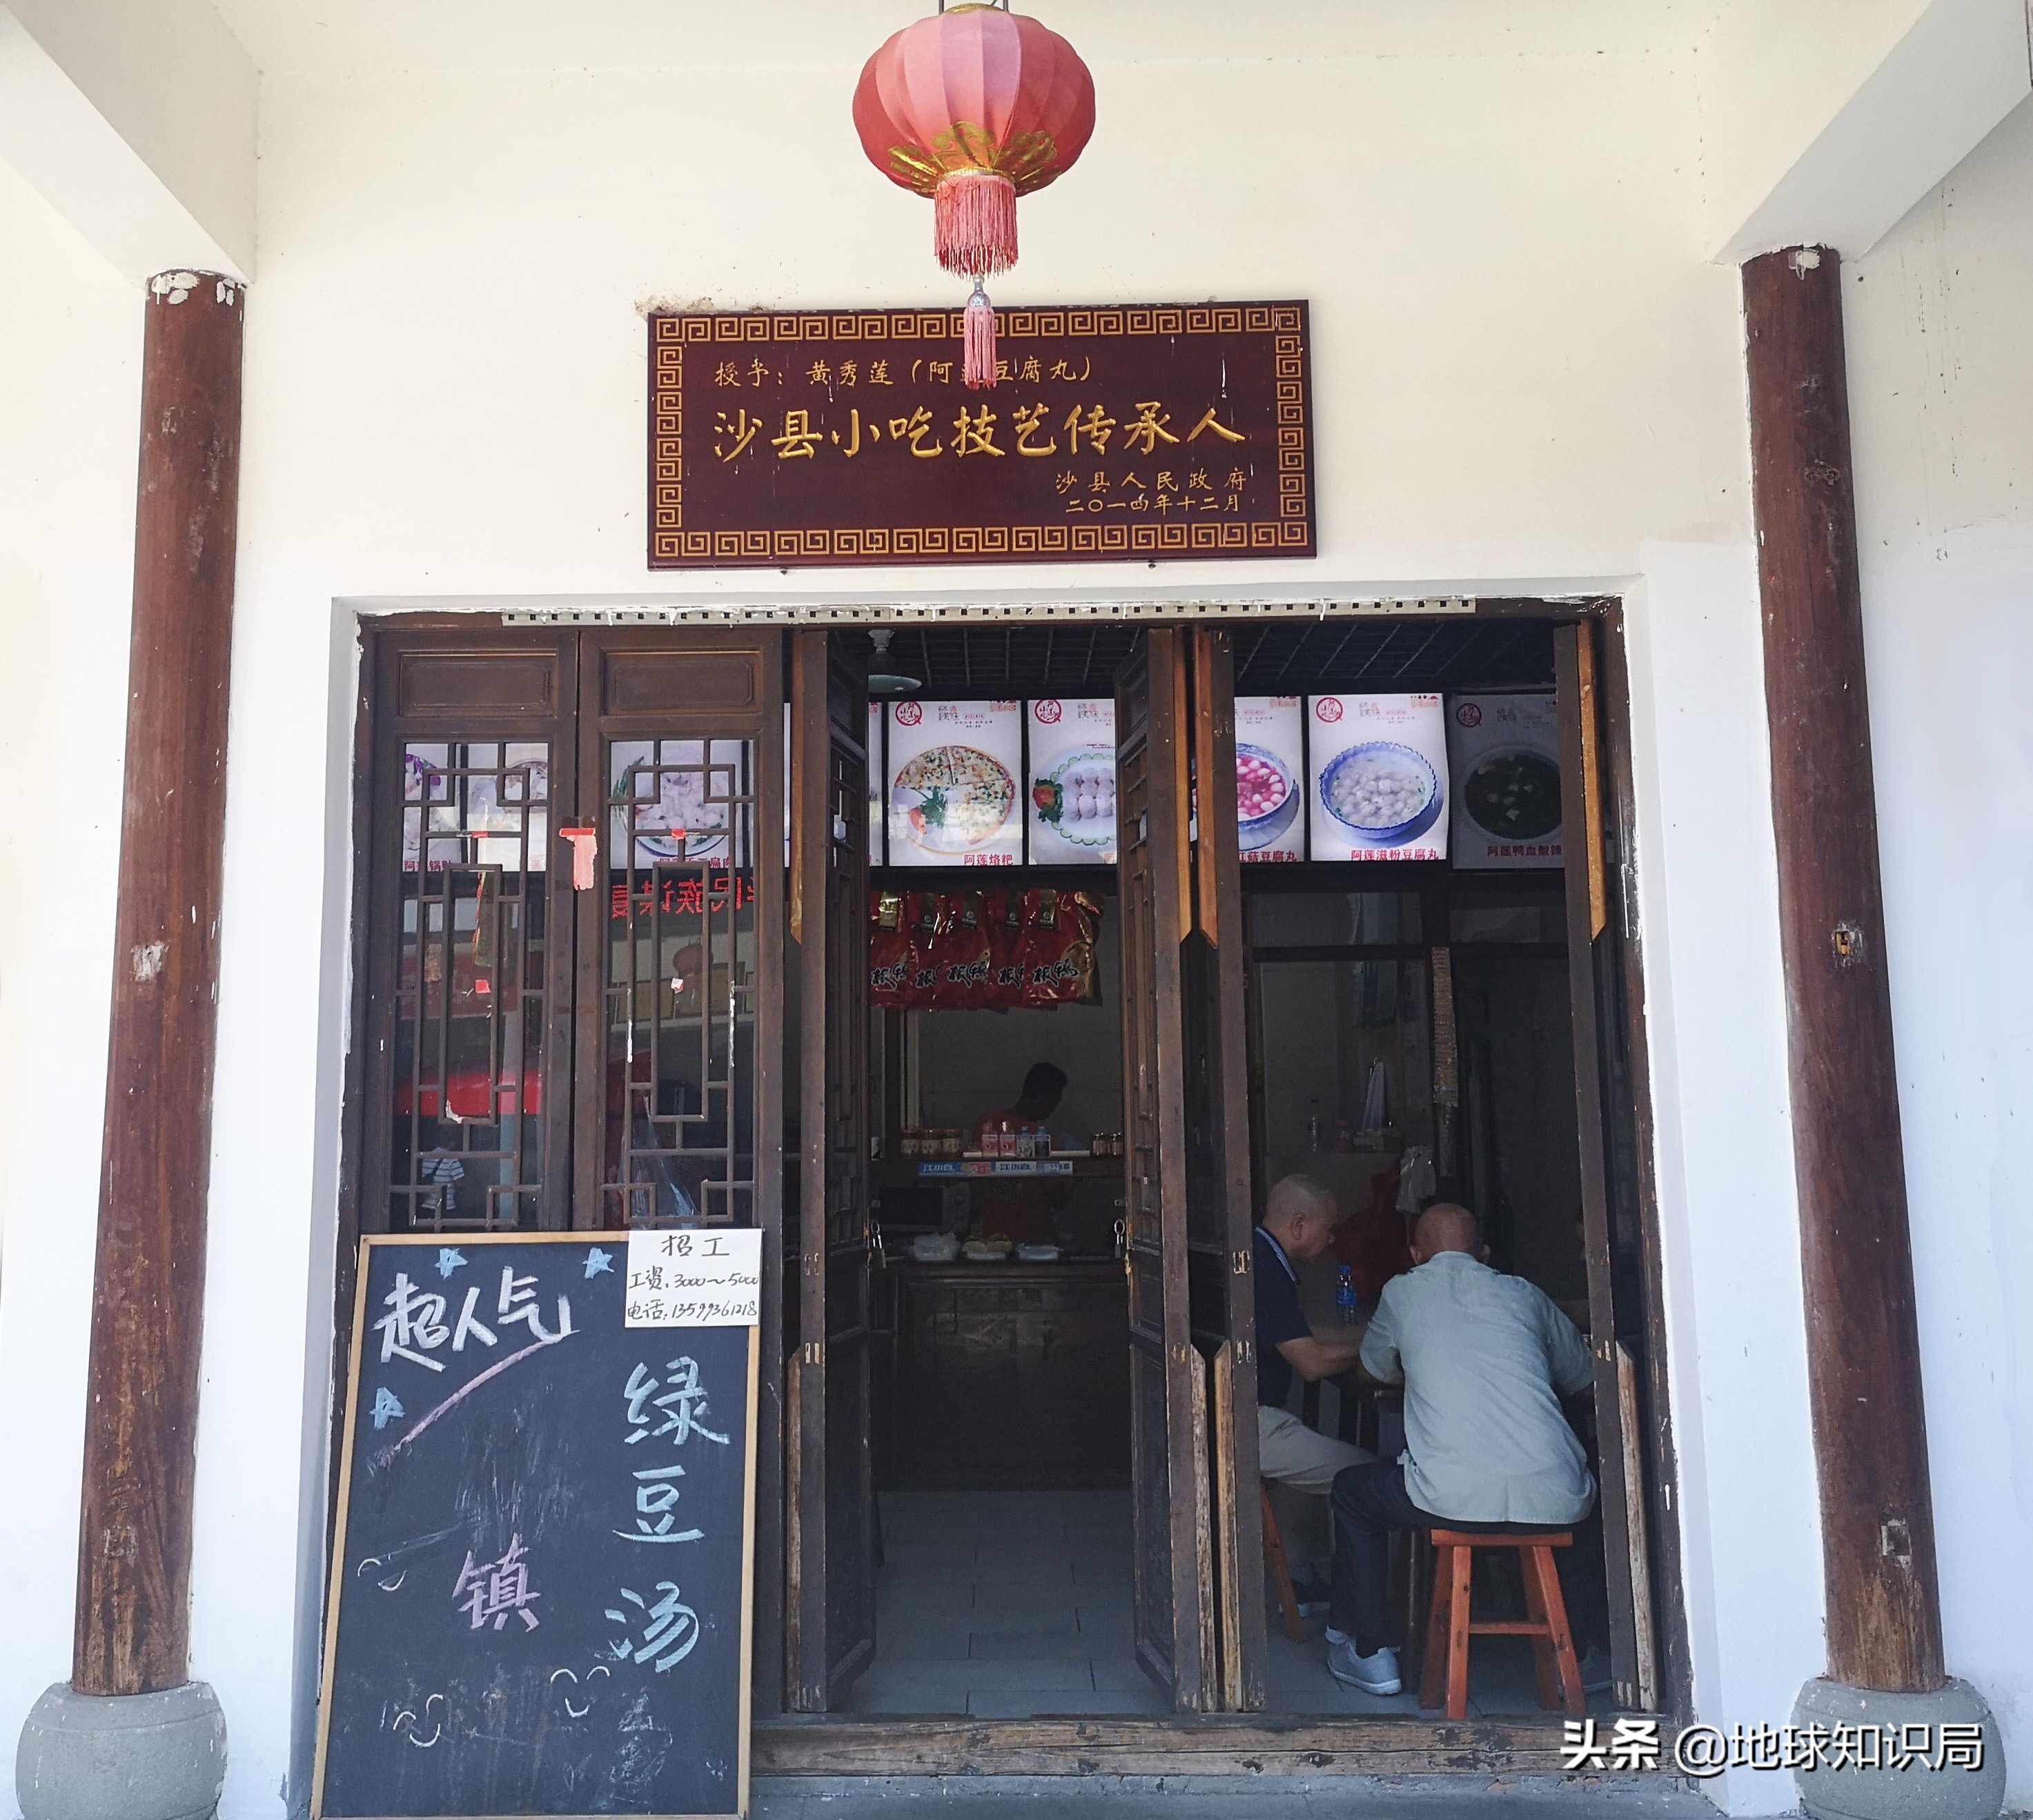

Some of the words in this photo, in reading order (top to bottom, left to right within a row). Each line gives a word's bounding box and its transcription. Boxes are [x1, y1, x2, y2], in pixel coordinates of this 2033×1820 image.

[714, 355, 1090, 387] 授予：黄秀莲（阿豆腐丸）
[714, 402, 1246, 463] 沙县小吃技艺传承人
[1056, 467, 1247, 494] 沙县人民政府
[661, 1235, 729, 1256] 招工
[373, 1266, 580, 1372] 超人气
[602, 1356, 730, 1672] 绿豆汤
[452, 1532, 541, 1632] 镇
